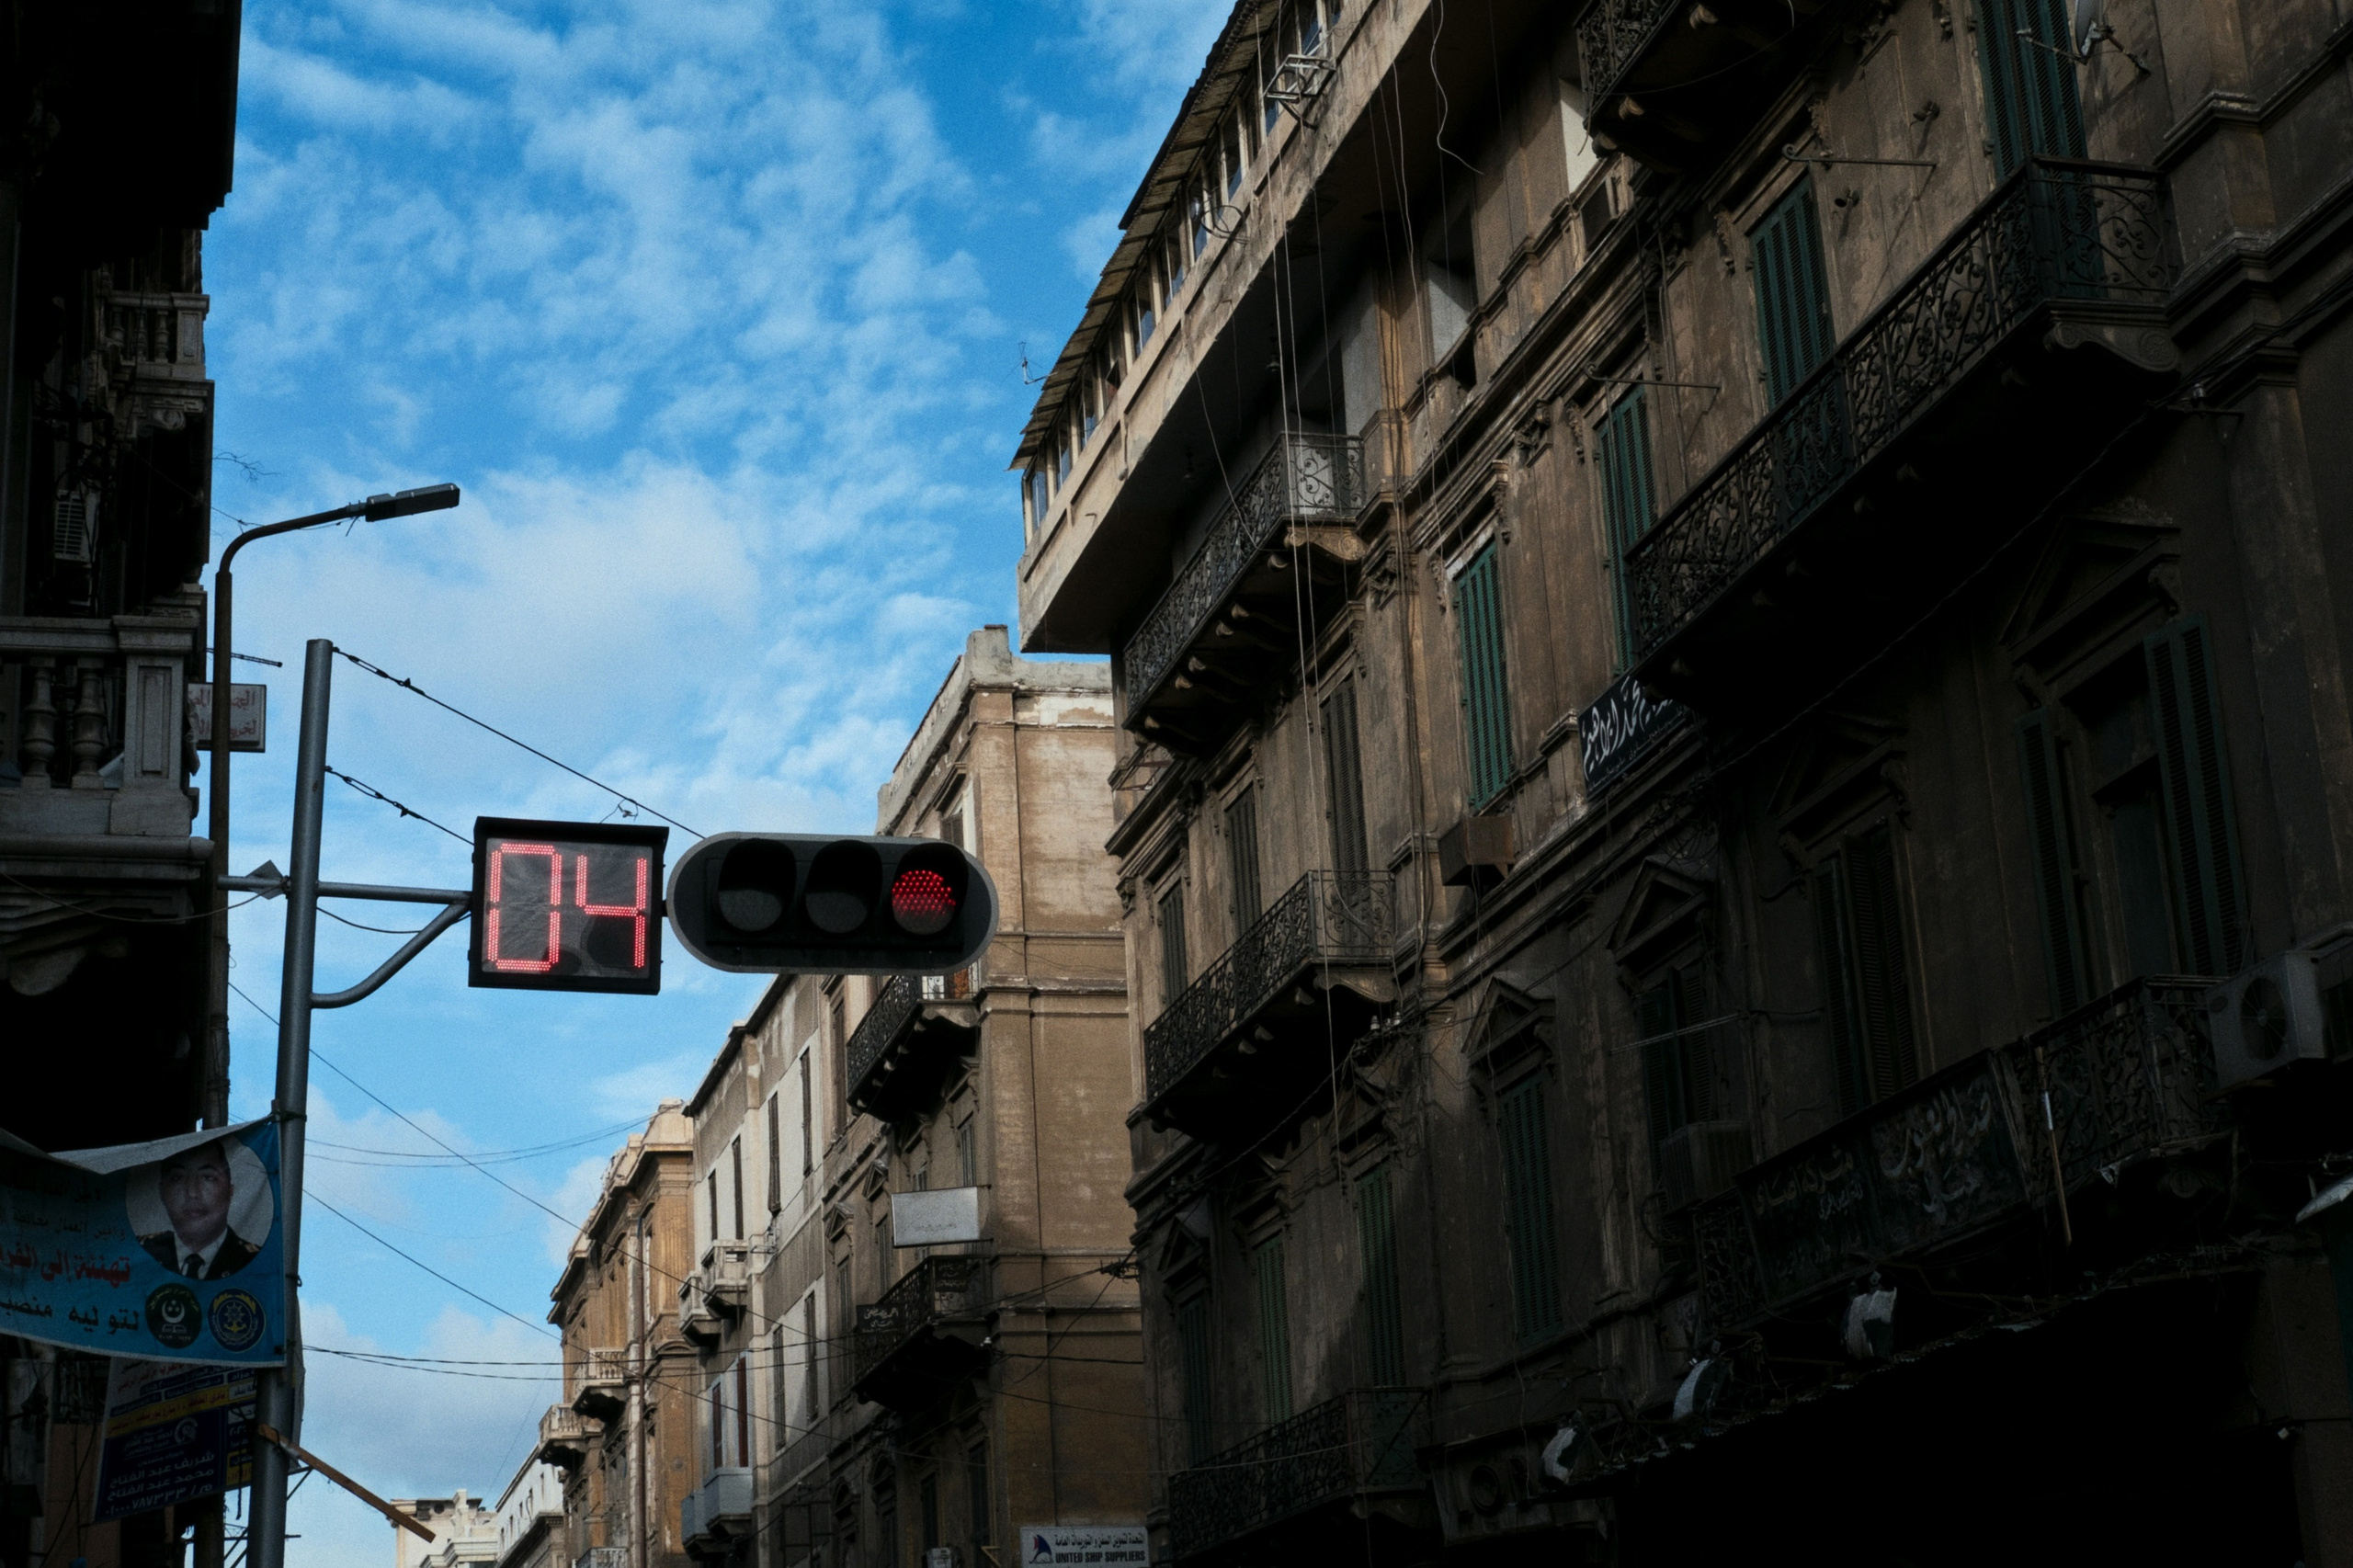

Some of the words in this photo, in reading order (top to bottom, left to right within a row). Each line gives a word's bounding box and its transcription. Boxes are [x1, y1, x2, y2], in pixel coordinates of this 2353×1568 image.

[486, 842, 648, 972] 04
[40, 1249, 72, 1283] إلى
[74, 1251, 131, 1289] تهنئة
[174, 1449, 215, 1470] شريف
[109, 1469, 146, 1489] الفتاح
[147, 1463, 173, 1477] عبد
[173, 1468, 214, 1484] محمد
[107, 1482, 144, 1502] الفتاح
[145, 1478, 172, 1492] عبد
[1055, 1552, 1083, 1563] UNITED
[1085, 1551, 1103, 1562] SHIP
[1105, 1551, 1145, 1562] SUPPLIERS
